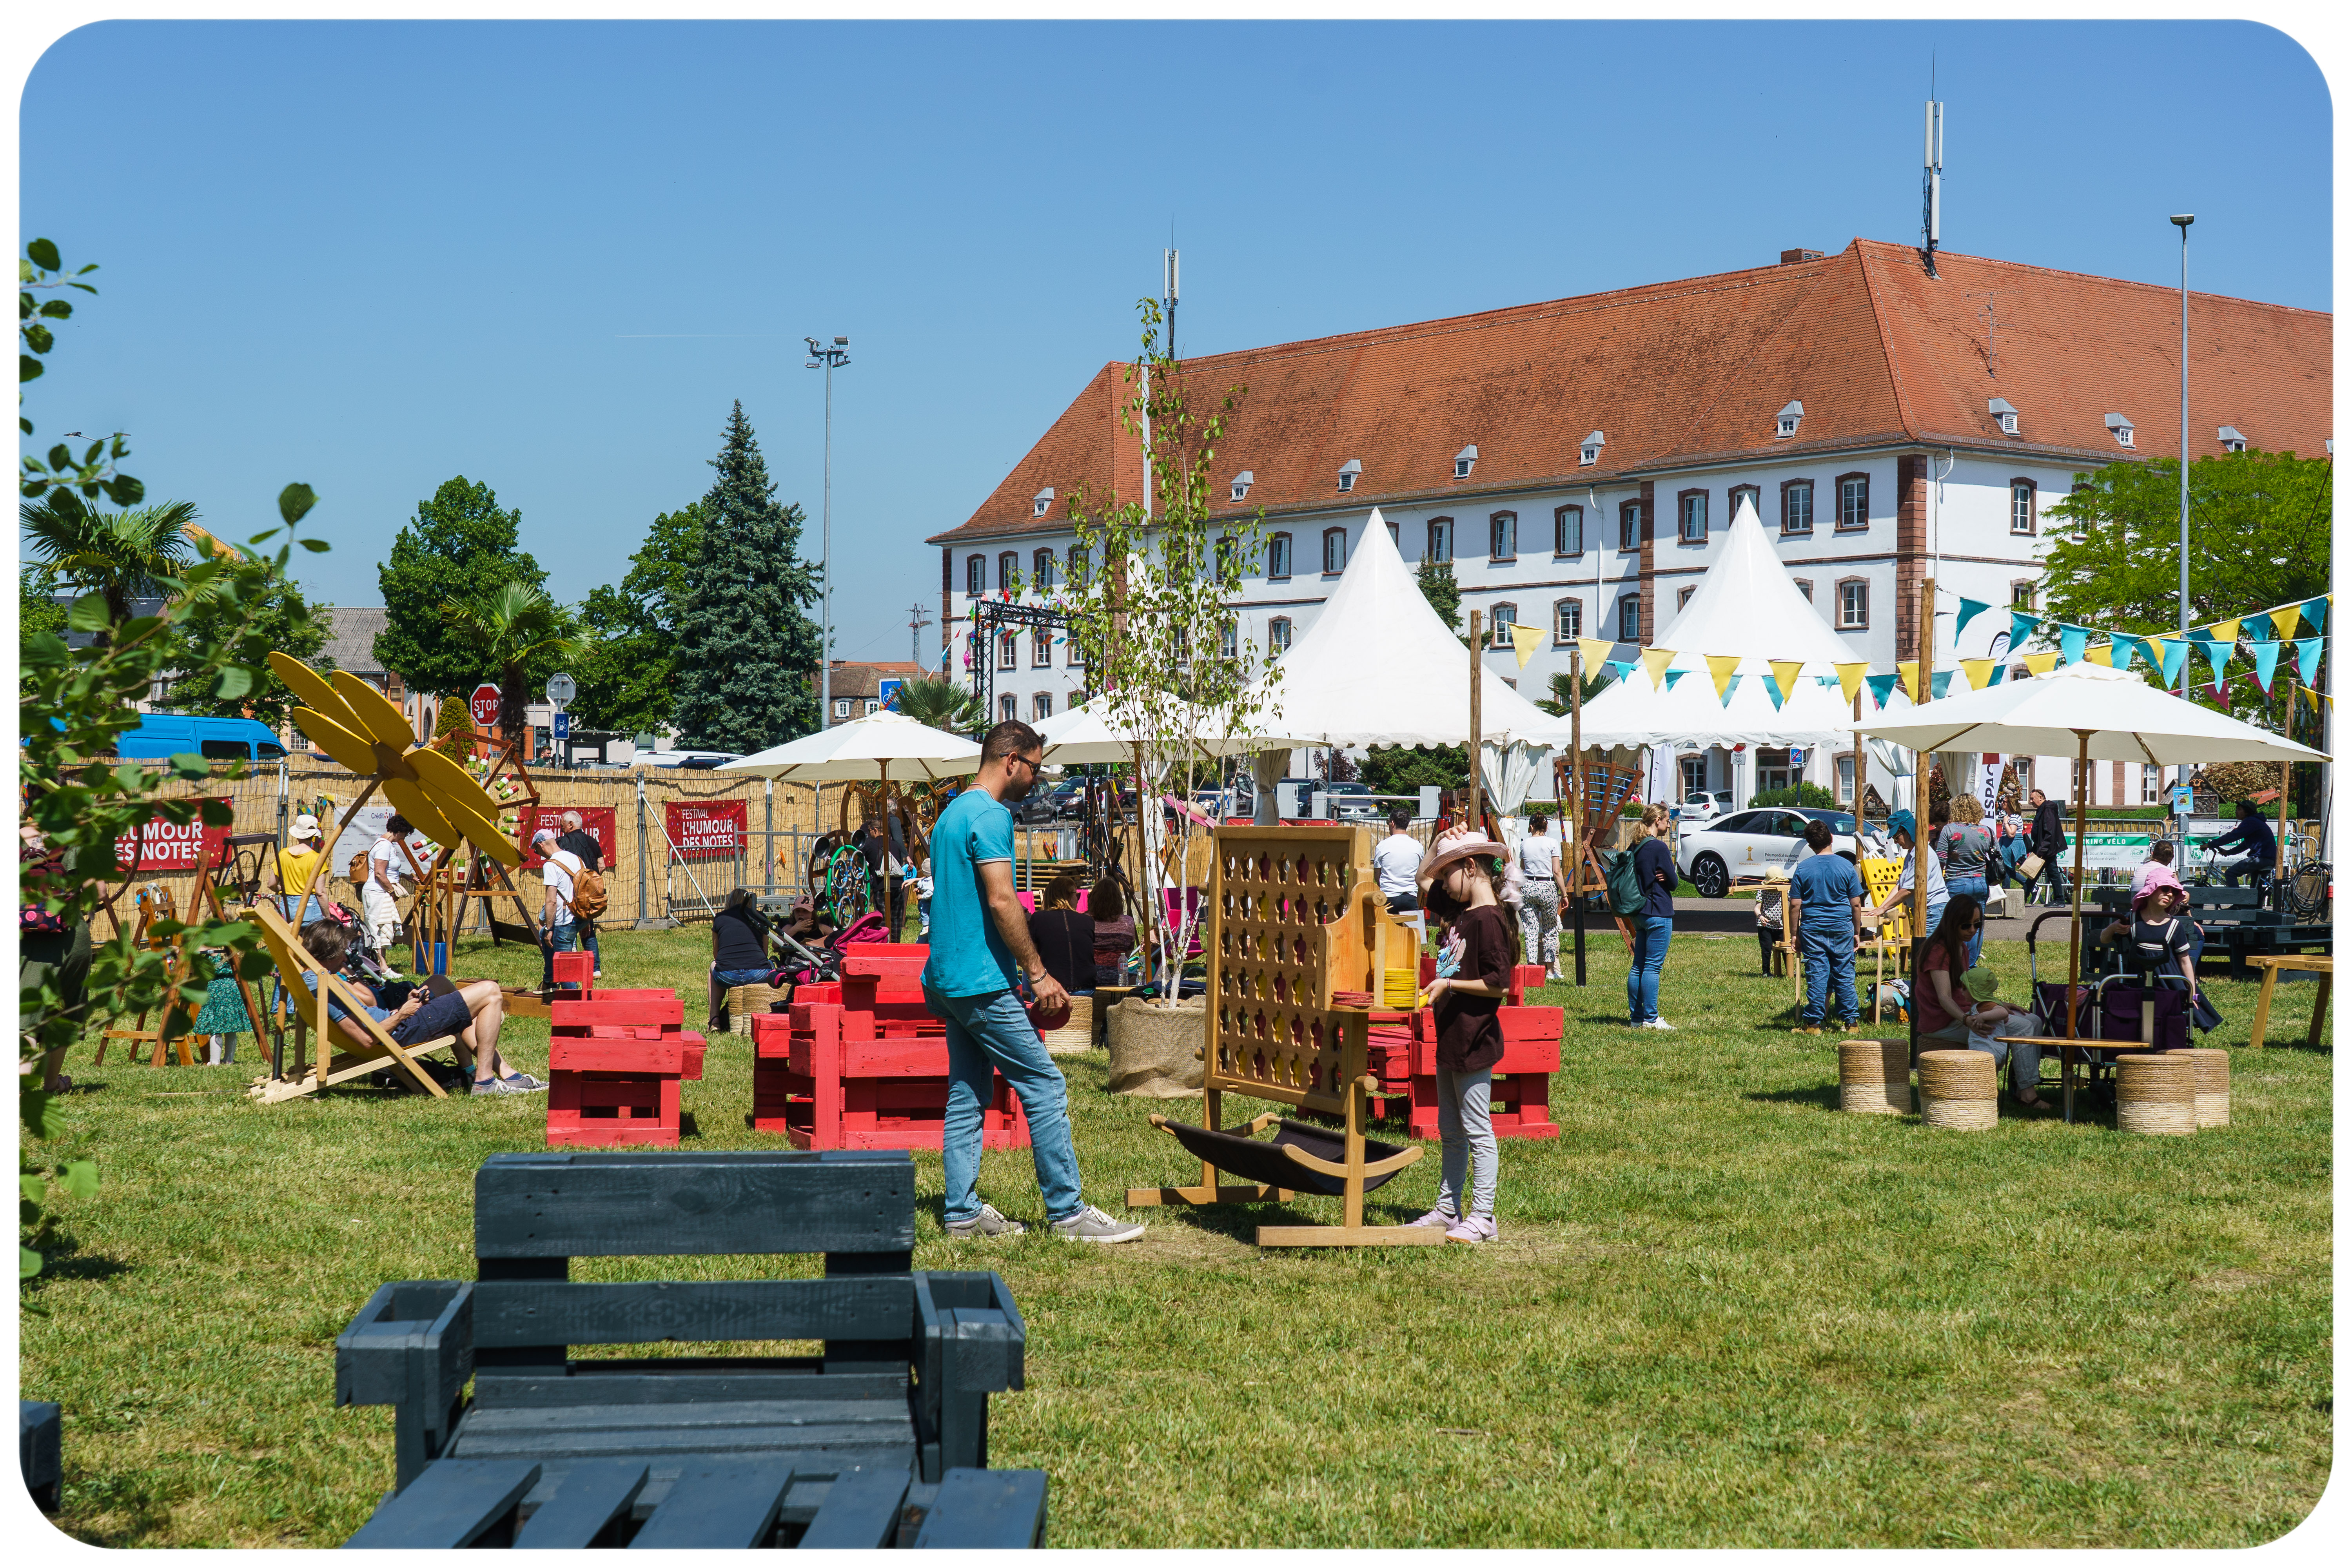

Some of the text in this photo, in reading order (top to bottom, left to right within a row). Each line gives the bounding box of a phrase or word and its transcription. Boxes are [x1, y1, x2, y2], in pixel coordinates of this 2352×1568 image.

[474, 699, 498, 711] STOP
[541, 815, 562, 826] FESTI
[682, 809, 709, 819] FESTIVAL
[682, 819, 733, 835] L'HUMOUR
[683, 834, 733, 851] DES NOTES
[141, 841, 202, 860] NOTES
